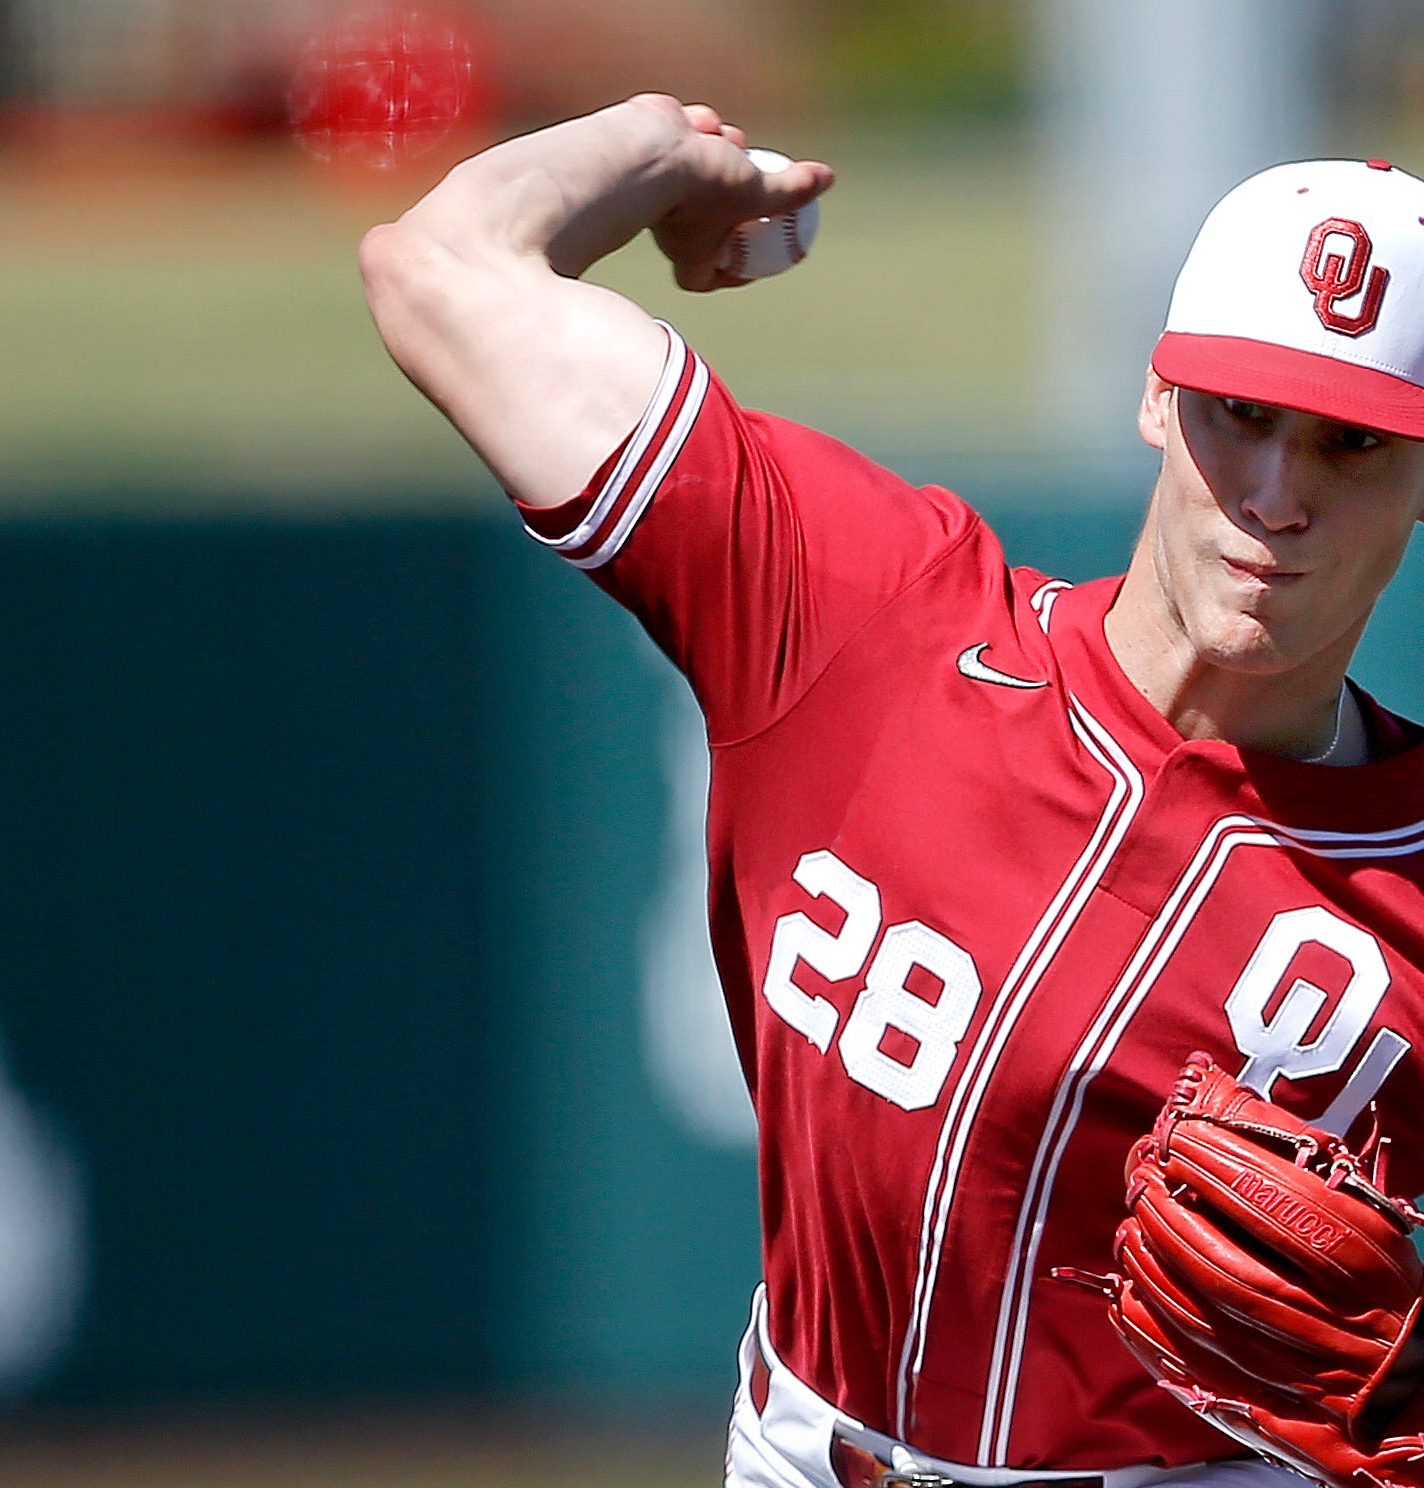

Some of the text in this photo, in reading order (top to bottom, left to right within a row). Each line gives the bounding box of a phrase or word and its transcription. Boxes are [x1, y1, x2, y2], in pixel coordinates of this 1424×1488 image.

[1299, 216, 1391, 340] OU
[762, 848, 983, 1112] 28
[1231, 1169, 1353, 1253] marucci
